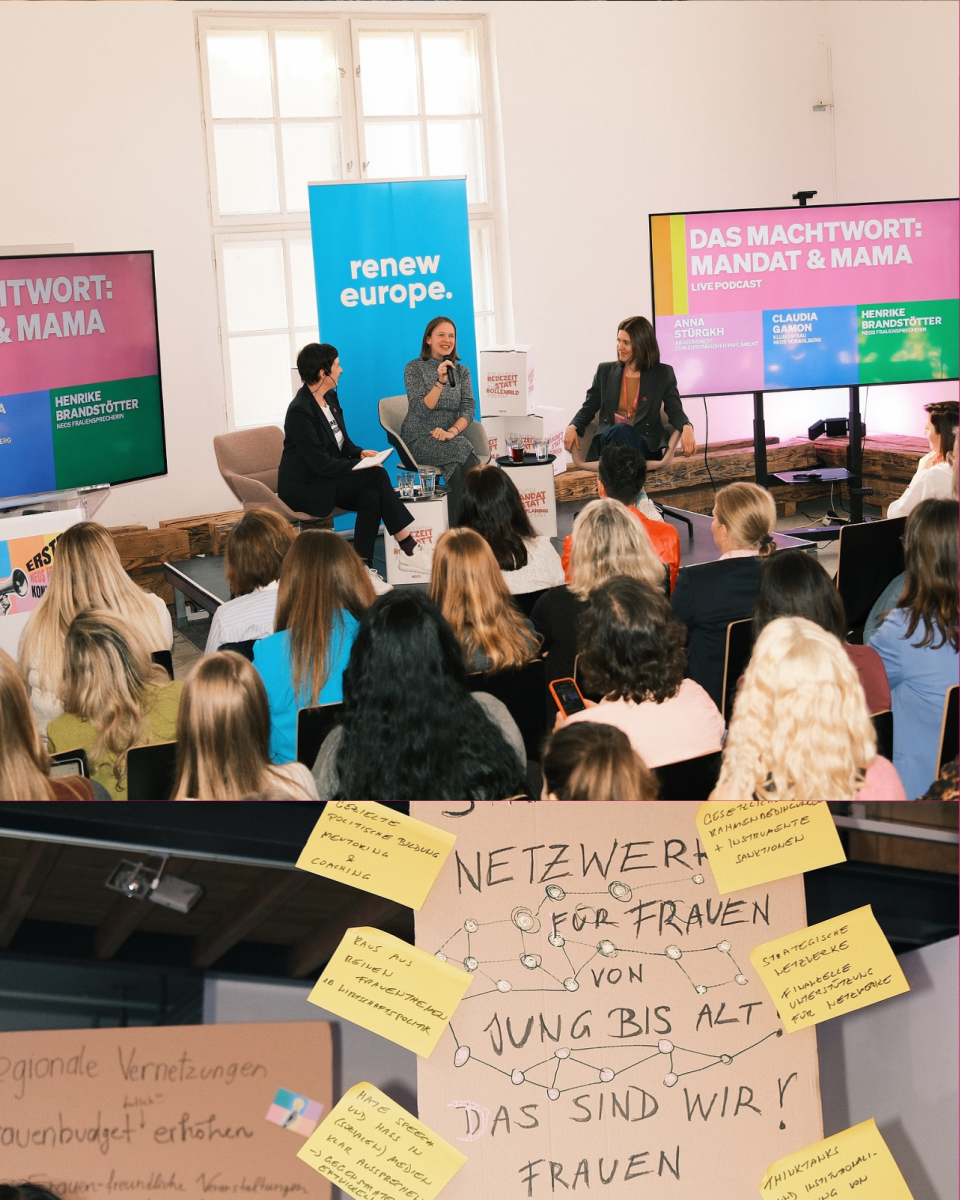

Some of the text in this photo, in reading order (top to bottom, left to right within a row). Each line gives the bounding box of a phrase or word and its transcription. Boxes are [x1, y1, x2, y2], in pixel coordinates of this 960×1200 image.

[689, 217, 923, 250] DAS MACHTWORT:
[350, 254, 441, 280] renew
[691, 244, 913, 276] MANDAT & MAMA
[340, 280, 454, 310] europe.
[691, 279, 763, 291] LIVE PODCAST
[16, 308, 106, 342] MAMA
[674, 317, 706, 328] ANNA
[772, 312, 818, 323] CLAUDIA
[861, 308, 905, 319] HENRIKE
[861, 316, 942, 330] BRANDSTÖTTER
[674, 326, 725, 339] STÜRGKH
[772, 323, 813, 333] GAMON
[876, 327, 927, 335] FRAUENSPRECHERIN
[495, 380, 518, 390] STATT
[54, 390, 102, 408] HENRIKE
[55, 398, 140, 422] BRANDSTÖTTER
[56, 412, 125, 430] NEOS FRAUENSPRECHERIN
[520, 491, 546, 501] ANDAT
[30, 569, 47, 584] NEOS
[320, 831, 389, 858] MENTORING
[327, 813, 441, 858] POLITISCHE BILDUNG
[715, 815, 811, 853] + INSTRUMENTE
[736, 834, 805, 864] SANKTIONEN
[310, 857, 371, 880] COACHING
[552, 894, 770, 938] FÜR FRAUEN
[354, 935, 414, 967] RAUS AUS
[762, 925, 848, 967] STRATEGISCHE
[774, 940, 850, 976] NETZWERKE
[344, 955, 394, 977] REINEN
[592, 964, 644, 987] VON
[484, 1002, 763, 1055] JUNG BIS ALT
[791, 1009, 815, 1025] FÜR
[0, 1045, 267, 1100] egionale Vernetzungen
[356, 1090, 434, 1147] HATE SPEECH
[454, 1085, 660, 1138] DAS SIND
[0, 1111, 138, 1155] auenbudget
[347, 1105, 423, 1156] UND HASS IN
[326, 1134, 352, 1155] KLAR
[387, 1156, 433, 1186] MEDIEN
[518, 1145, 681, 1198] FRAUEN
[763, 1146, 839, 1191] THINKTANKS
[849, 1175, 868, 1189] VON
